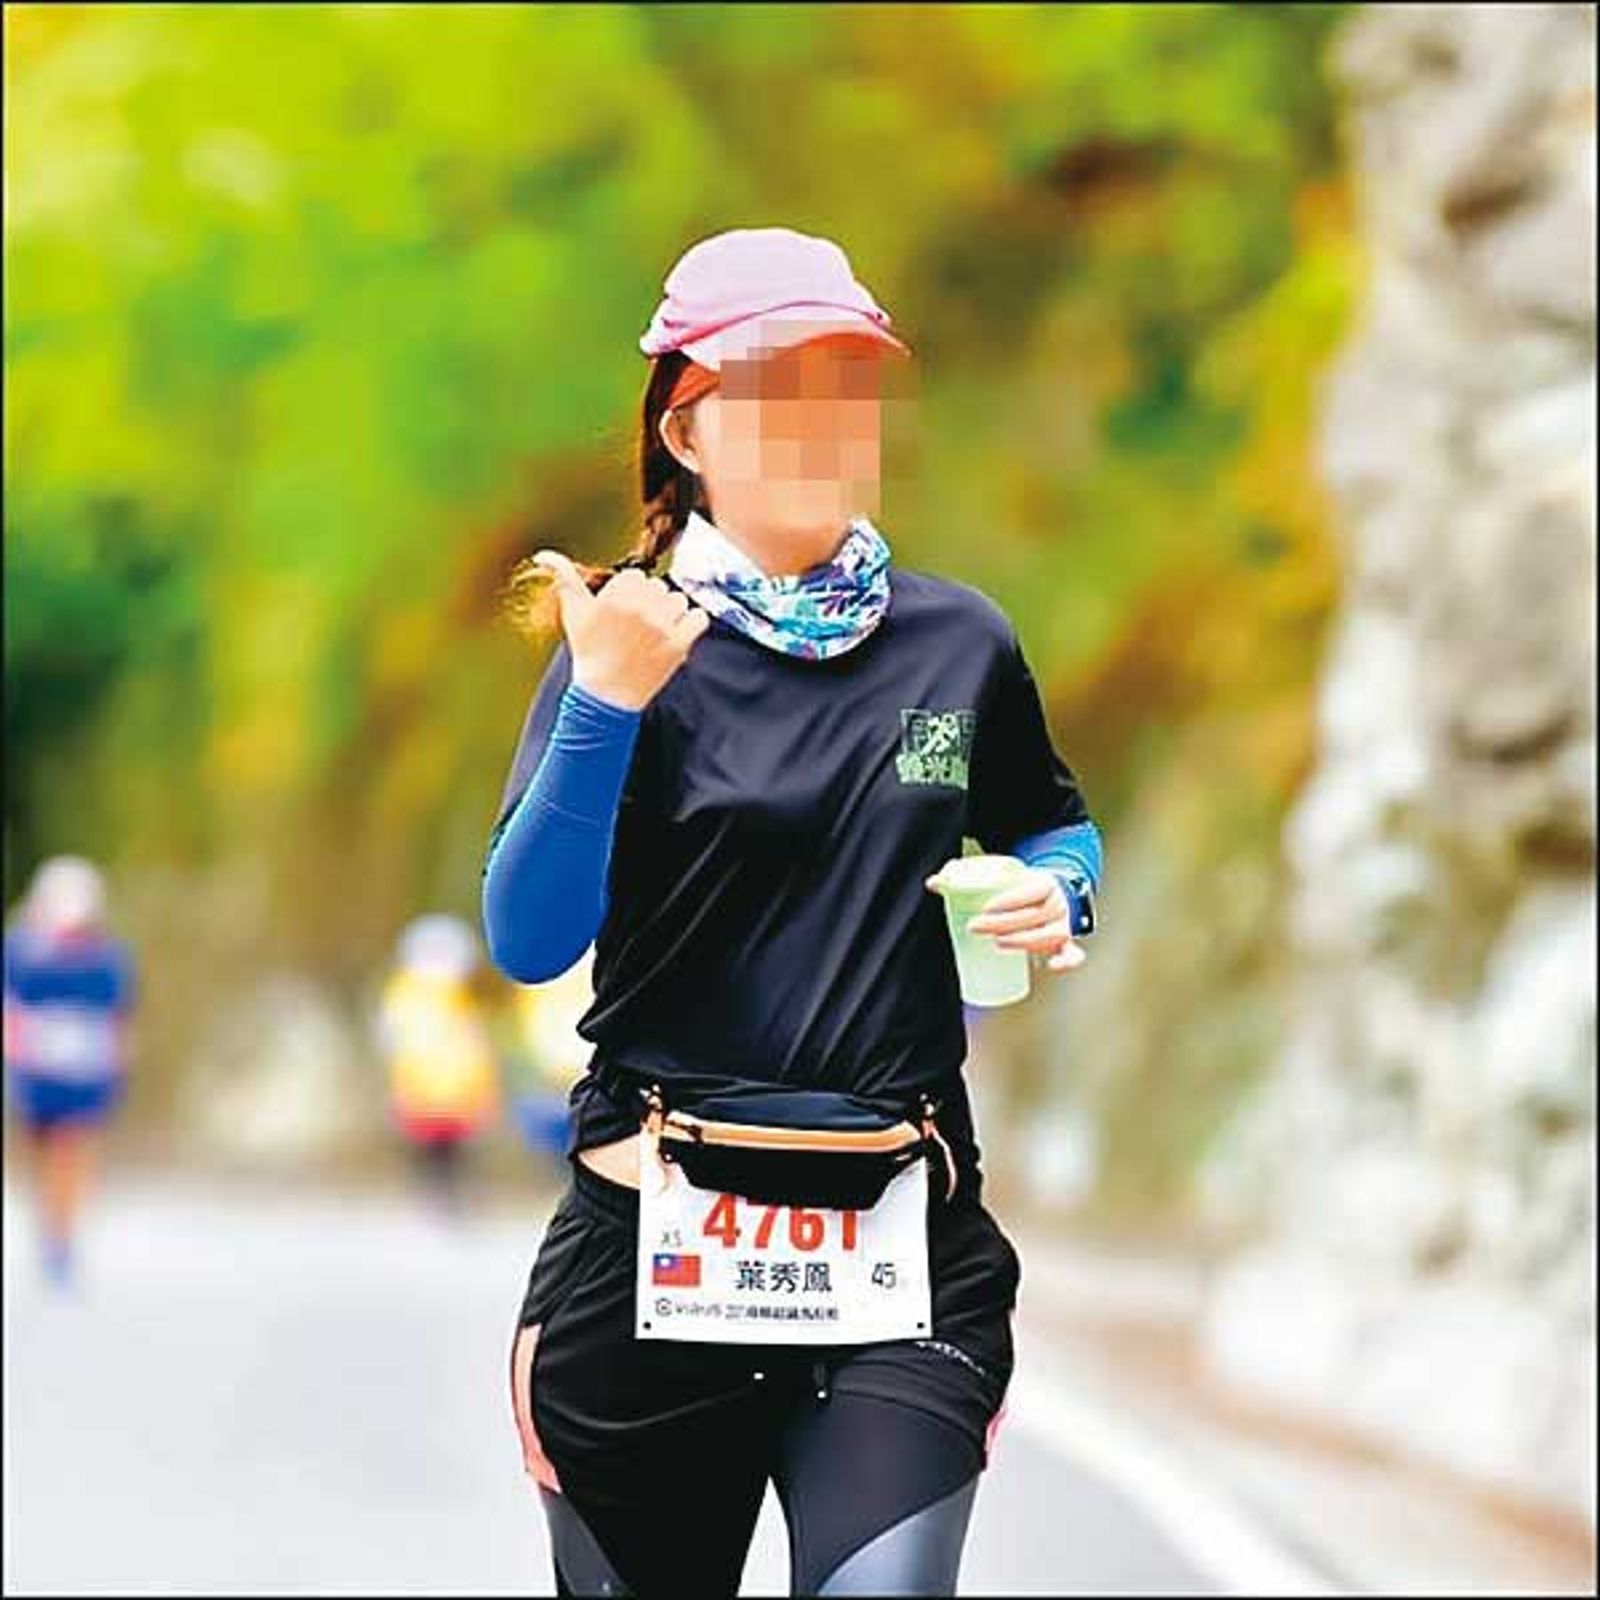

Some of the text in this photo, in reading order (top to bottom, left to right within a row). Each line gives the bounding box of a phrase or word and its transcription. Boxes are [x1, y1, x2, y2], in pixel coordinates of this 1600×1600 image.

[703, 1193, 858, 1251] 4761
[735, 1260, 832, 1293] 葉秀鳳
[871, 1262, 896, 1289] 45
